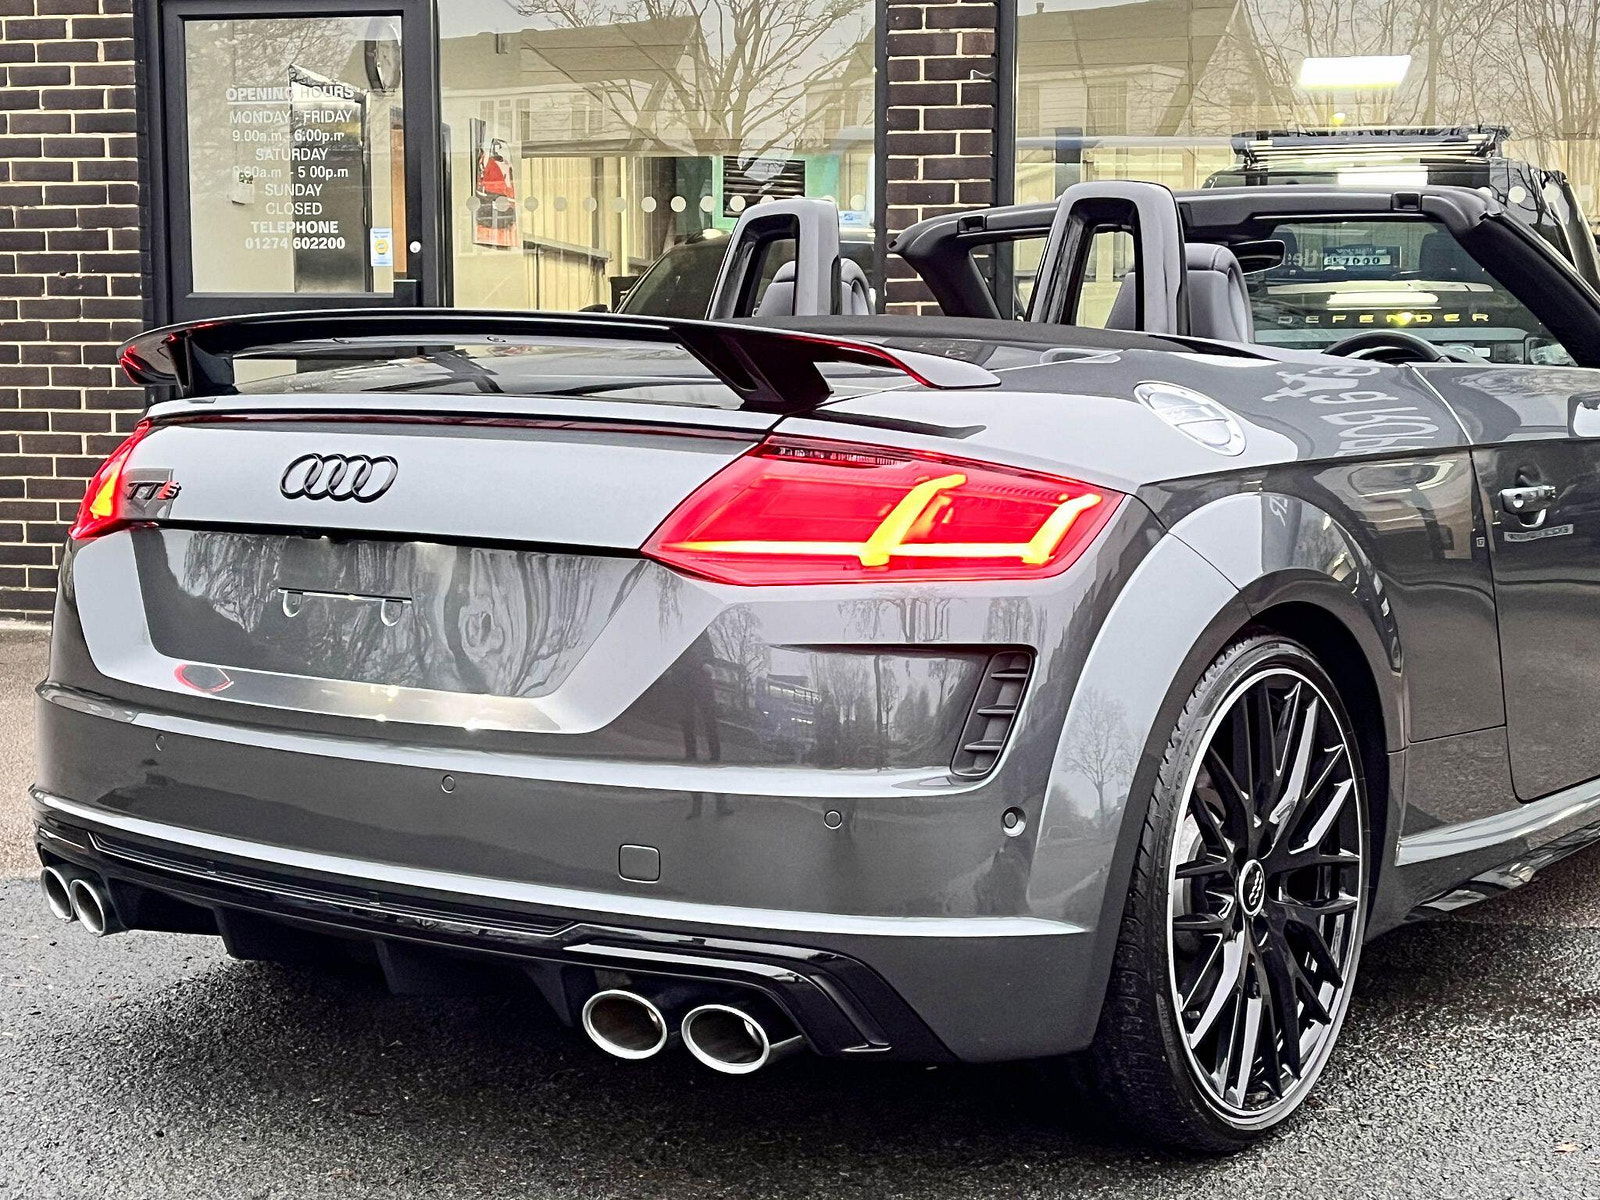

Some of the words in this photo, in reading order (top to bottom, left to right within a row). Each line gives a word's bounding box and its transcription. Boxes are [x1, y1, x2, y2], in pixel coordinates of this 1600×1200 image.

[225, 87, 294, 101] OPENING
[300, 86, 355, 100] HOURS
[229, 110, 291, 124] MONDAY
[303, 109, 353, 123] FRIDAY
[255, 147, 328, 161] SATURDAY
[265, 183, 323, 197] SUNDAY
[265, 202, 323, 216] CLOSED
[251, 220, 339, 235] TELEPHONE
[245, 236, 289, 250] 01274
[292, 236, 346, 250] 602200
[1277, 312, 1490, 325] DEFENDER
